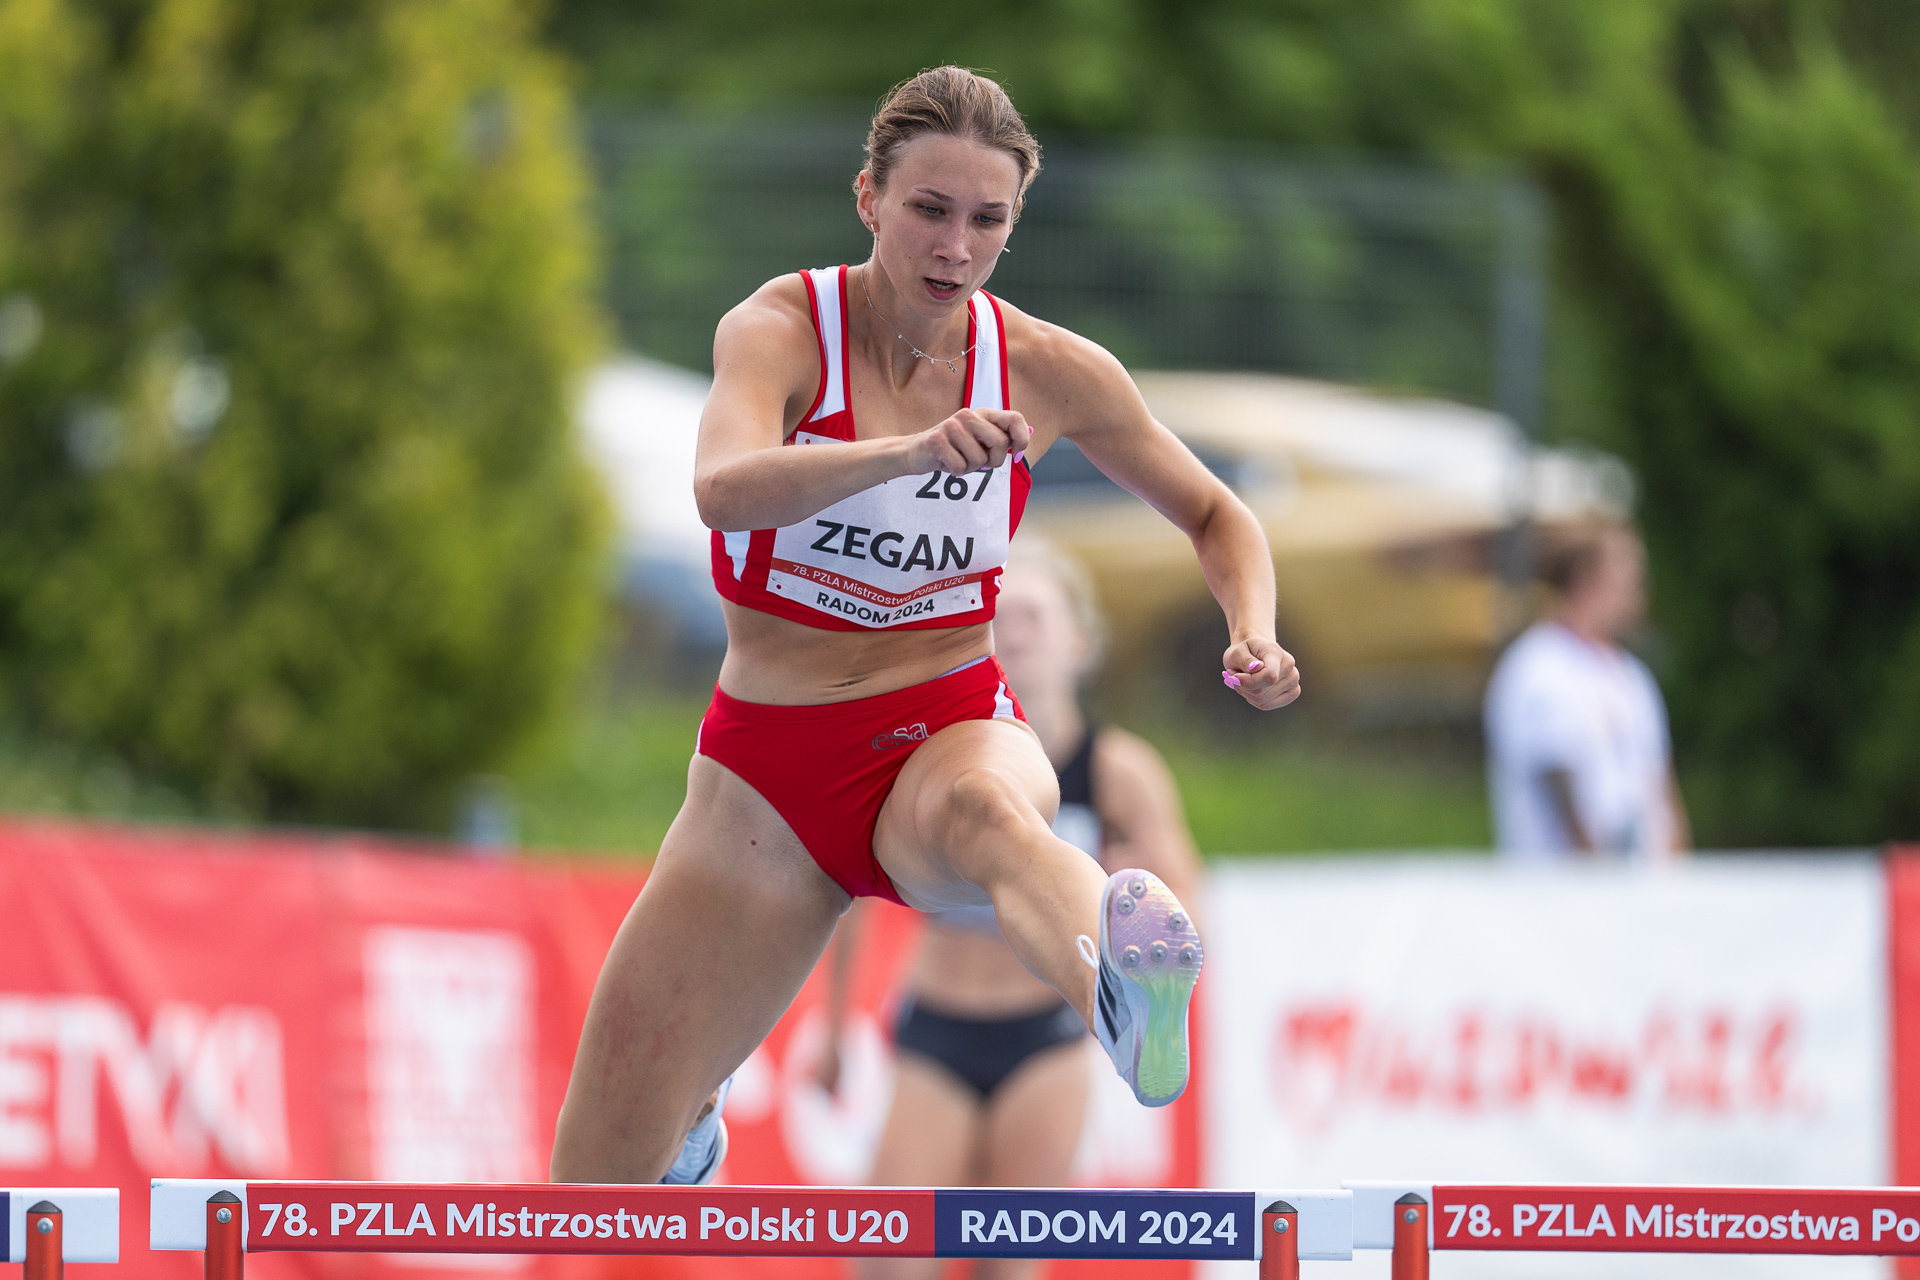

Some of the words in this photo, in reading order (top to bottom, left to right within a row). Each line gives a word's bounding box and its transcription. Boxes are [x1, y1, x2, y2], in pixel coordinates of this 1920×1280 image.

[915, 469, 994, 502] 267
[810, 519, 975, 572] ZEGAN
[792, 564, 810, 577] 78.
[812, 571, 841, 588] PZLA
[842, 580, 911, 606] Mistrzostwa
[912, 582, 944, 599] Polski
[944, 575, 966, 587] U20
[816, 591, 890, 624] RADOM
[892, 598, 935, 621] 2024
[259, 1202, 317, 1236] 78.
[331, 1202, 436, 1236] PZLA
[447, 1202, 686, 1240] Mistrzostwa
[700, 1207, 815, 1242] Polski
[828, 1209, 909, 1244] U20
[961, 1209, 1126, 1244] RADOM
[1138, 1211, 1238, 1246] 2024
[1443, 1203, 1502, 1238] 78.
[1512, 1204, 1616, 1237] PZLA
[1625, 1203, 1859, 1241] Mistrzostwa
[1871, 1208, 1920, 1243] Po
